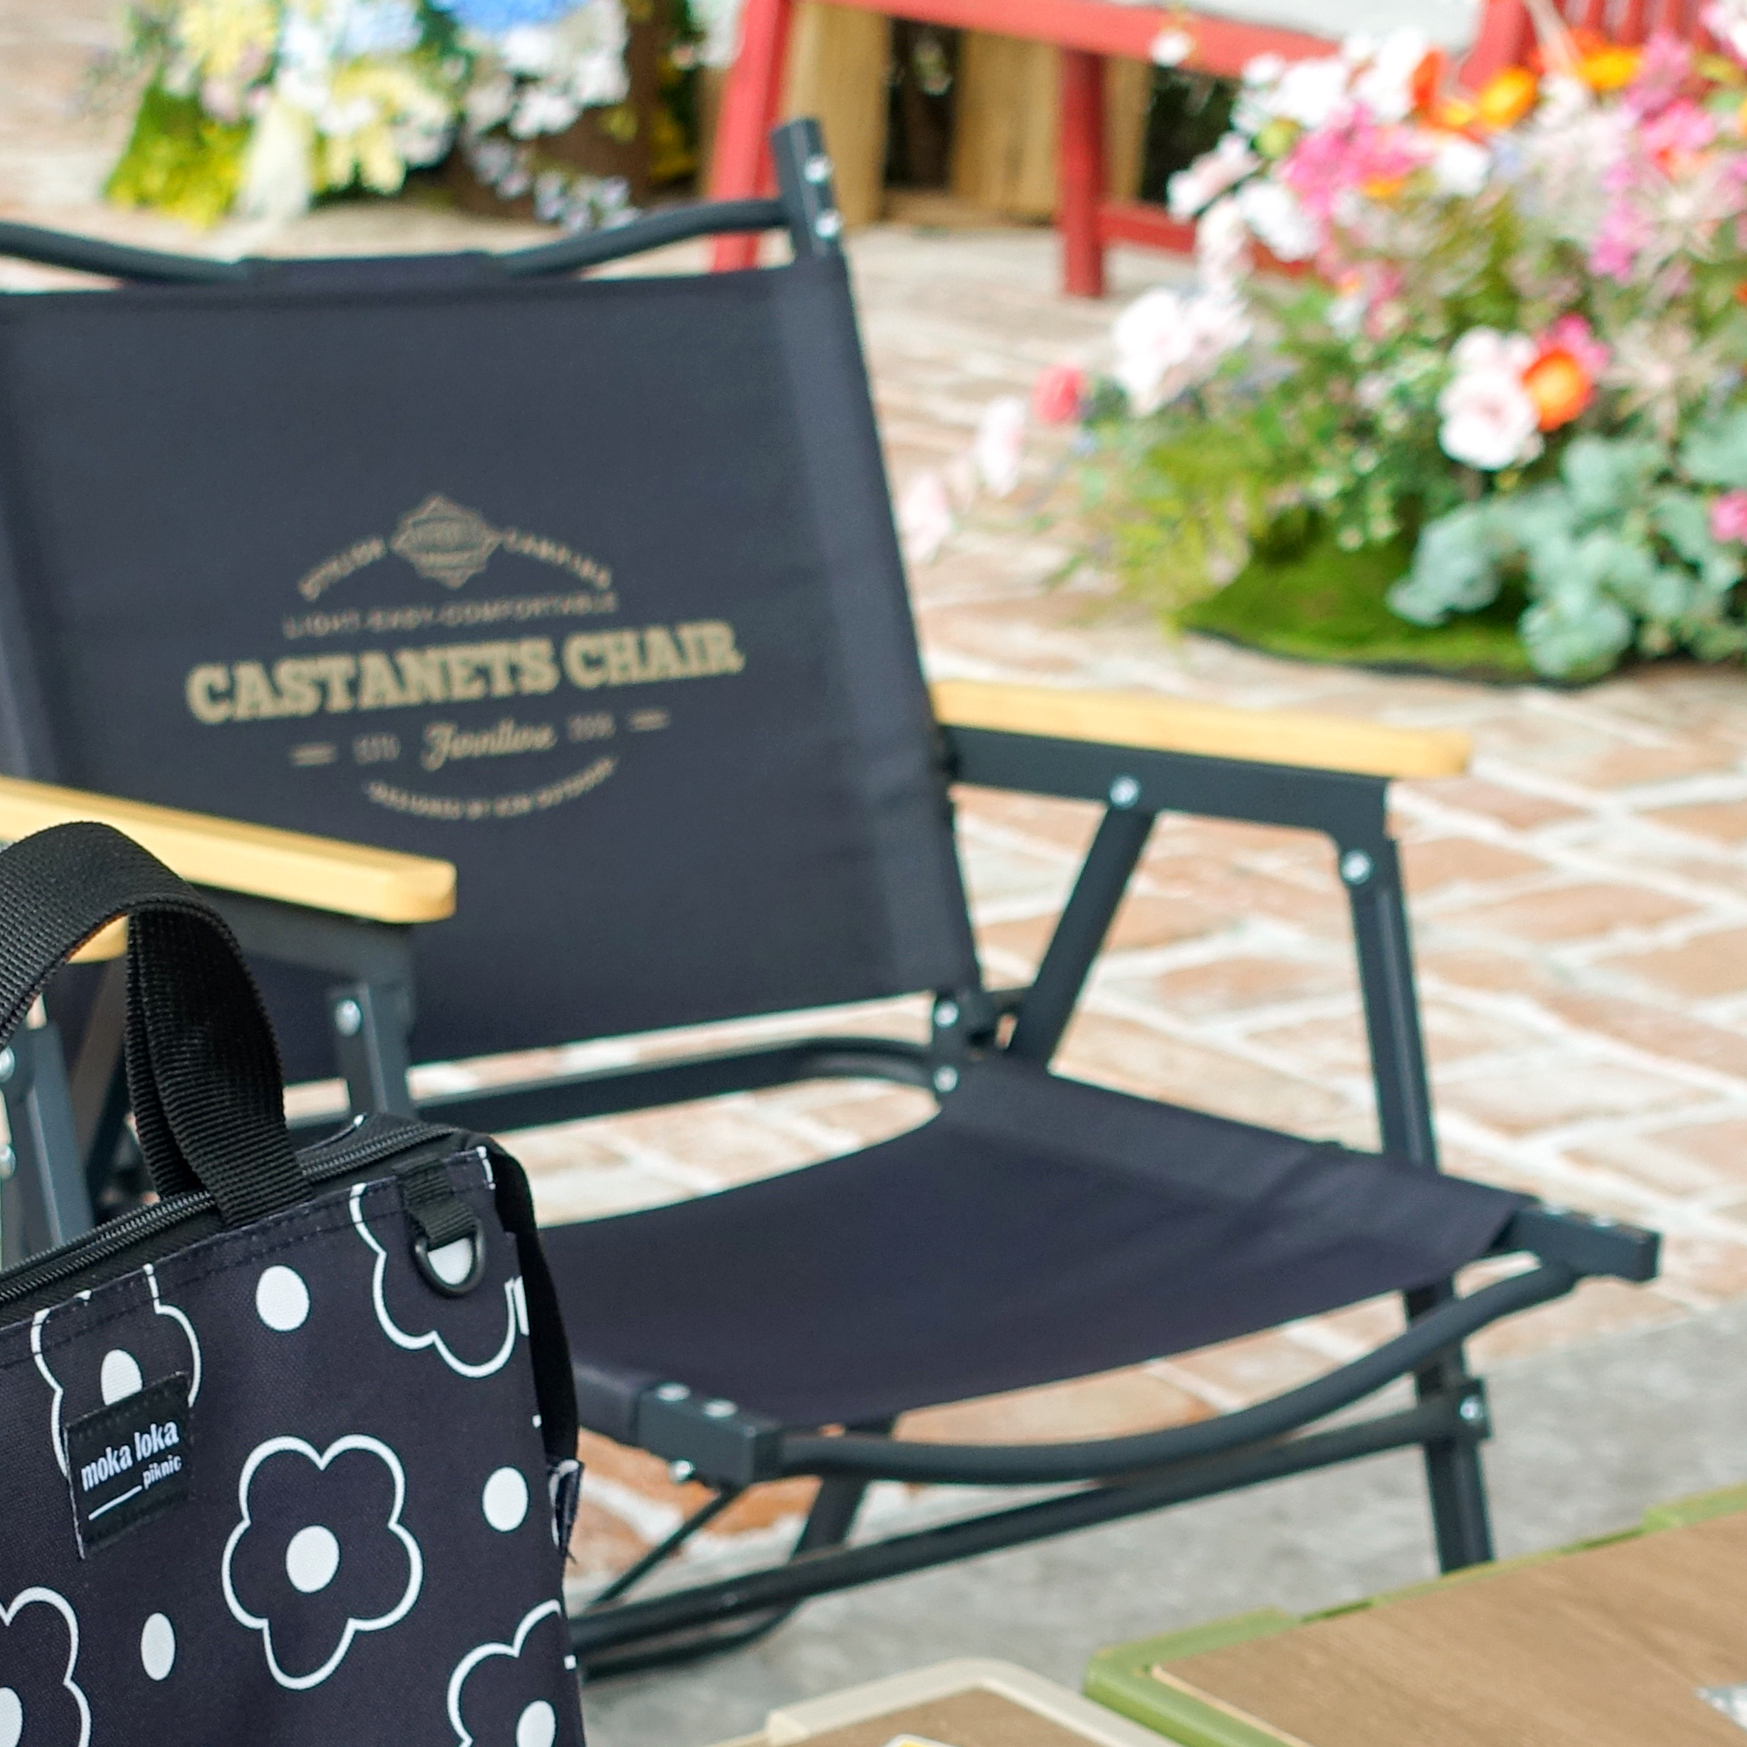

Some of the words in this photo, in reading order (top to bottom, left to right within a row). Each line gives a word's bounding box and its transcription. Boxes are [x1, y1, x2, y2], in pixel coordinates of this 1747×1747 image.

[186, 637, 559, 724] CASTANETS
[562, 619, 745, 689] CHAIR
[81, 1445, 133, 1492] moka
[133, 1421, 180, 1462] loka
[142, 1453, 182, 1490] piknic
